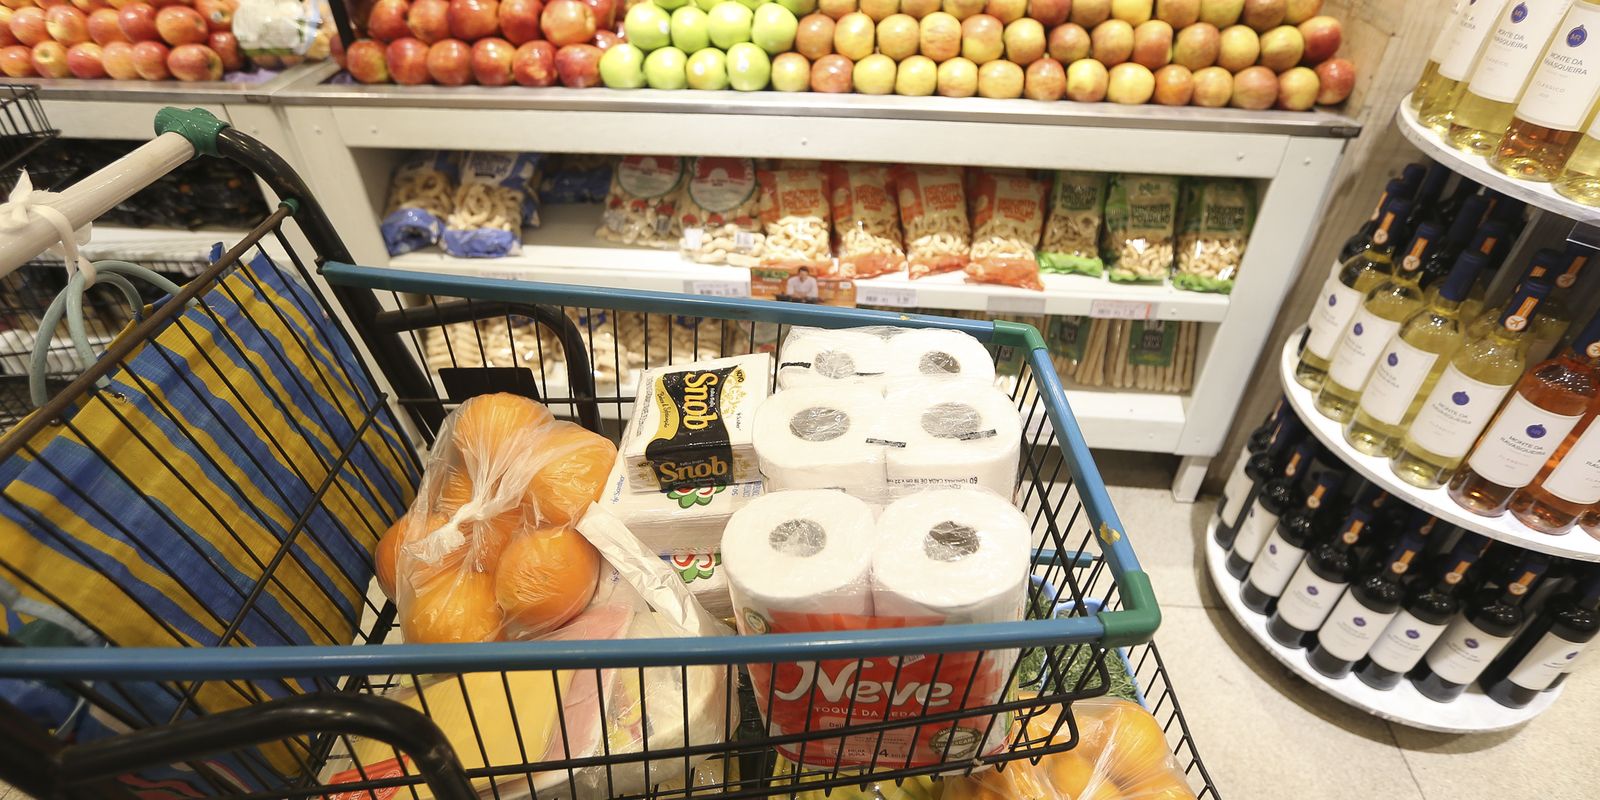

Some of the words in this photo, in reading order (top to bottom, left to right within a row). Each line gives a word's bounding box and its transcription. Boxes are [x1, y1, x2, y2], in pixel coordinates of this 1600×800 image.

[684, 372, 718, 430] Snob
[660, 456, 728, 482] Snob
[774, 660, 953, 706] Neve
[815, 707, 856, 716] TOQUE
[862, 709, 879, 717] DA
[878, 750, 888, 758] 4
